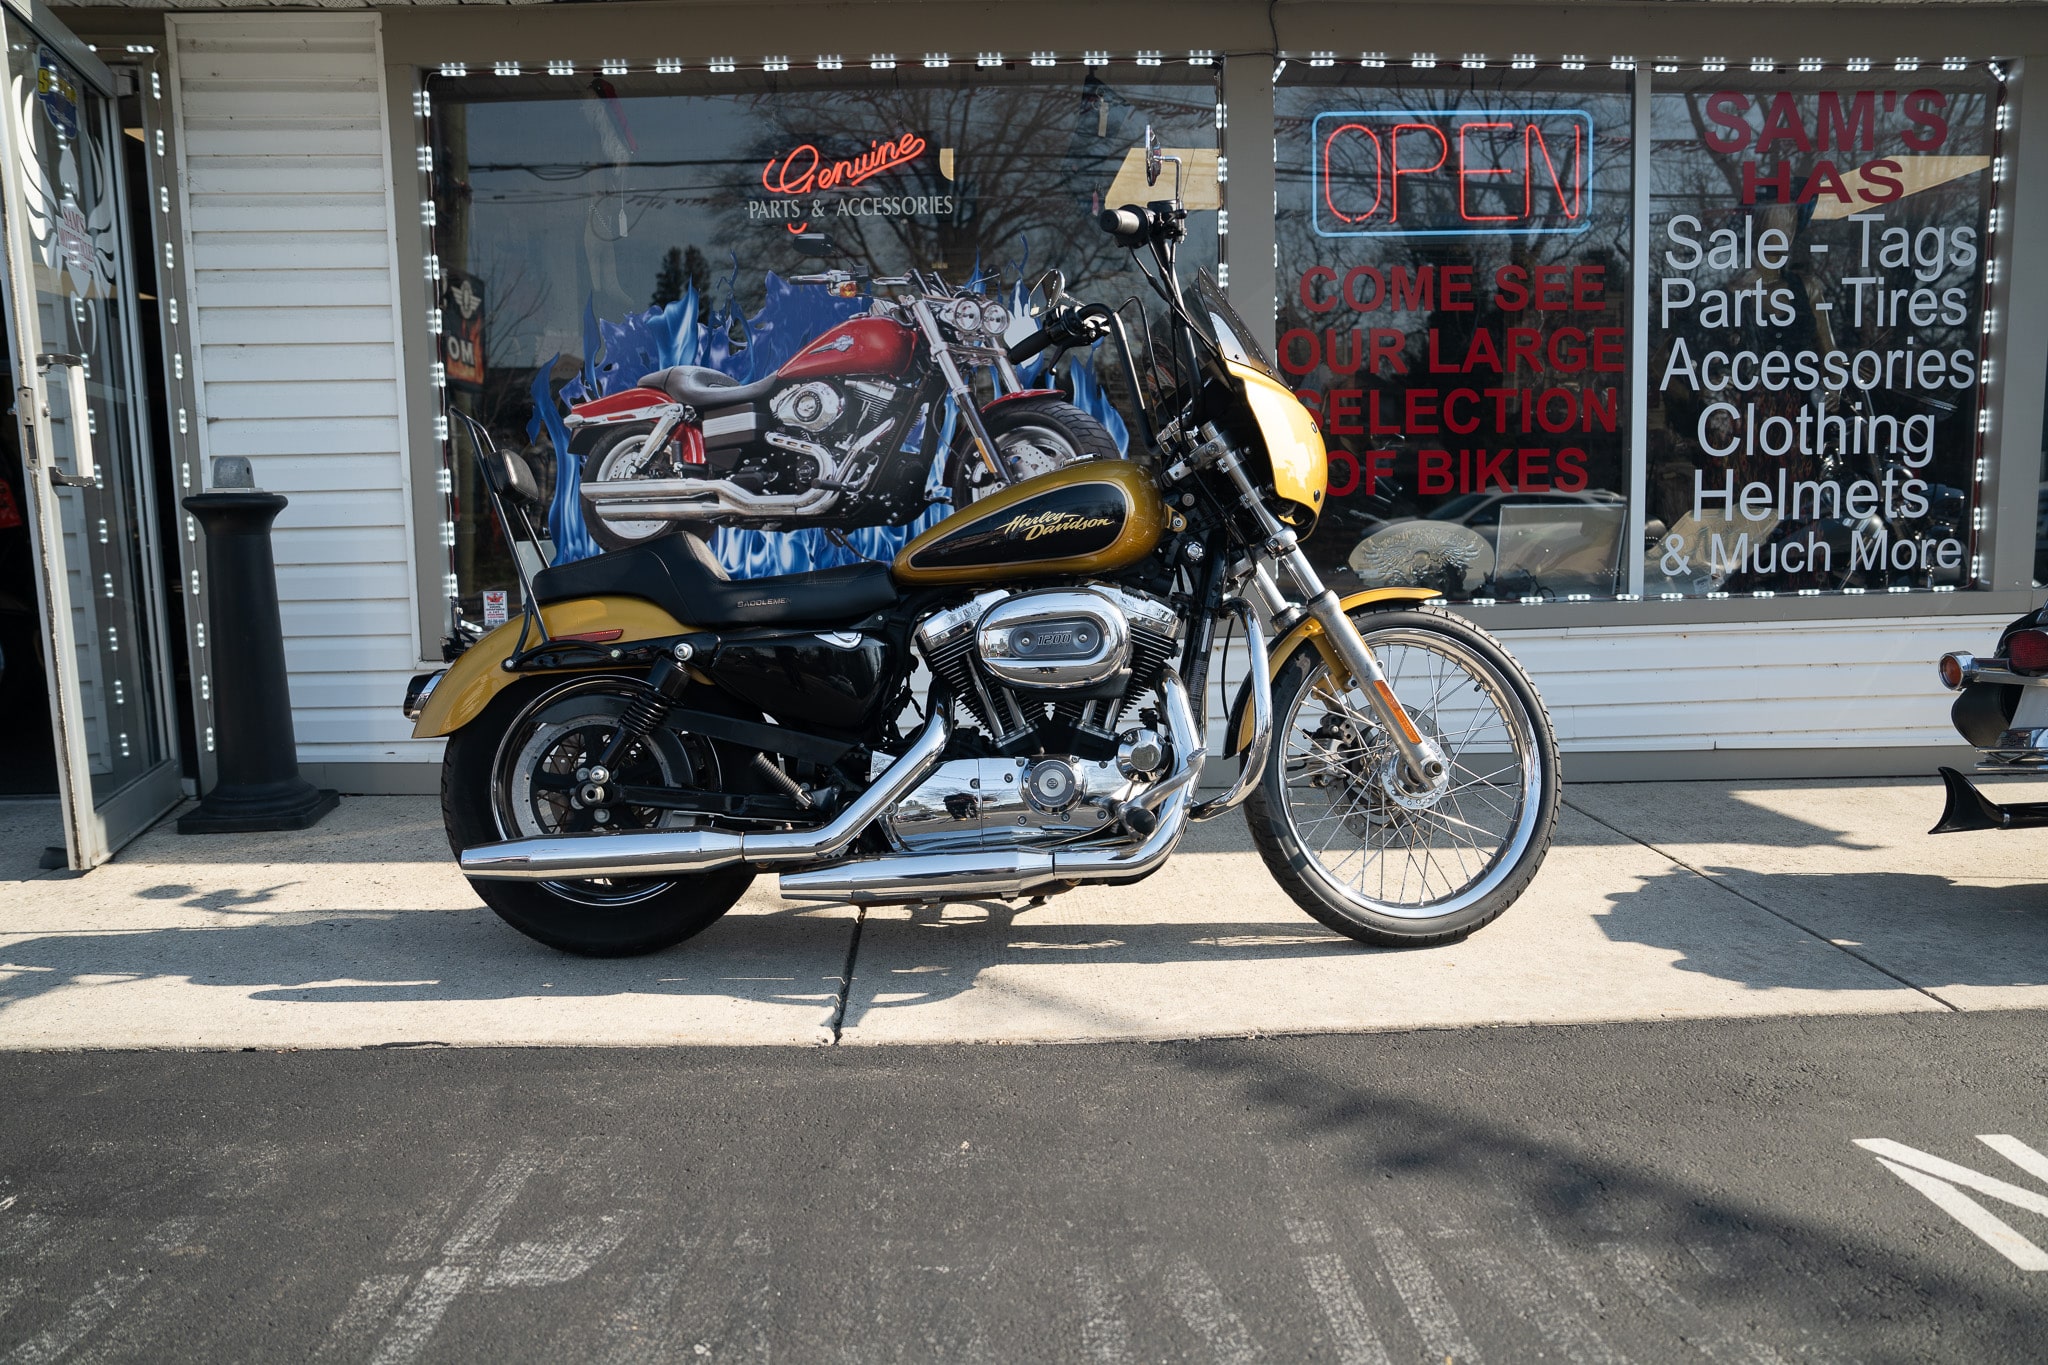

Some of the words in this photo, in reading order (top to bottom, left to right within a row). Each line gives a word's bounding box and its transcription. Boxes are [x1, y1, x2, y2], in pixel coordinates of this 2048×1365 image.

[1704, 88, 1948, 154] SAM'S
[762, 132, 926, 194] Genuine
[1324, 123, 1581, 223] OPEN
[1742, 159, 1905, 205] HAS
[749, 199, 800, 219] PARTS
[811, 199, 825, 218] &
[836, 195, 954, 217] ACCESSORIES
[1665, 213, 1790, 271] Sale
[1848, 213, 1978, 283] Tags
[1300, 265, 1475, 312] COME
[1494, 265, 1607, 312] SEE
[1661, 277, 1797, 329] Parts
[1841, 276, 1968, 328] Tires
[1278, 327, 1408, 375] OUR
[1428, 327, 1626, 374] LARGE
[1659, 336, 1976, 392] Accessories
[1697, 401, 1936, 469] Clothing
[1327, 451, 1397, 497] OF
[1417, 447, 1589, 495] BIKES
[1693, 467, 1930, 522] Helmets
[1021, 516, 1116, 541] Davidson
[1660, 533, 1692, 577] &
[1710, 530, 1832, 575] Much
[1850, 529, 1963, 572] More
[1037, 633, 1073, 646] 1200
